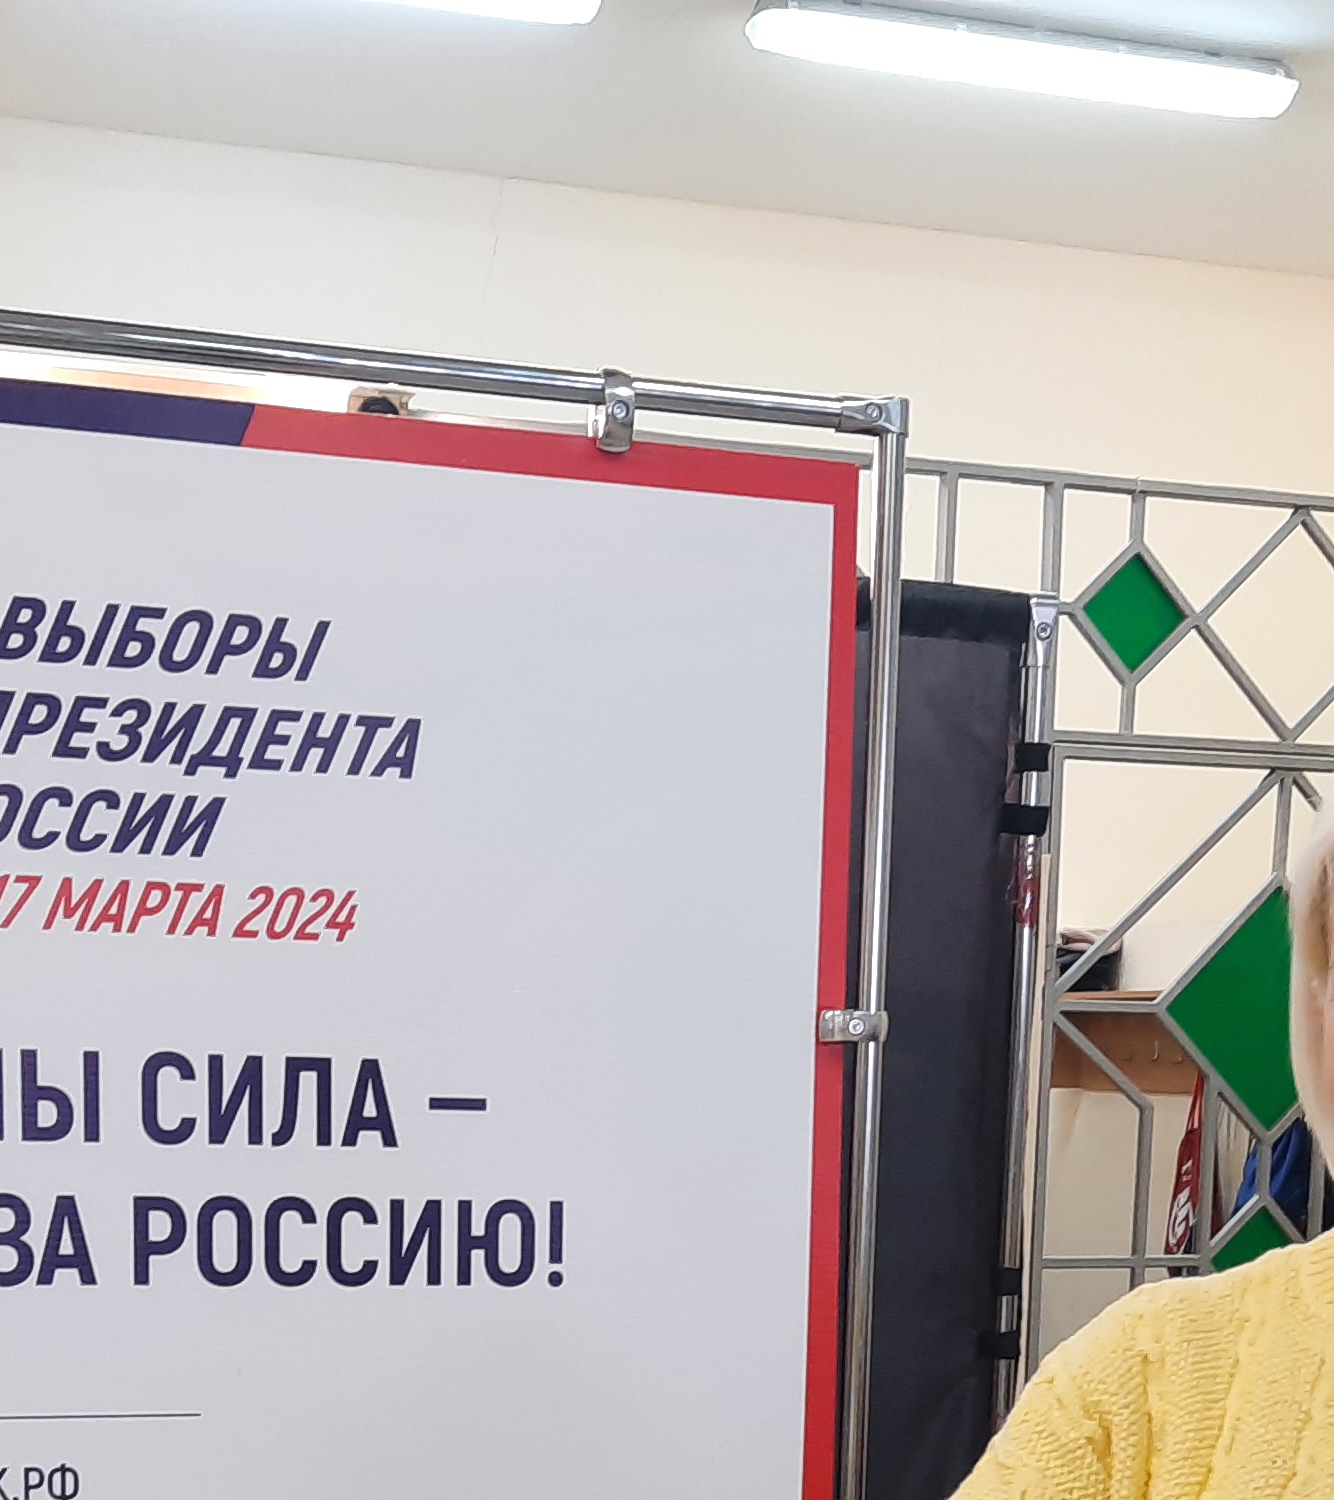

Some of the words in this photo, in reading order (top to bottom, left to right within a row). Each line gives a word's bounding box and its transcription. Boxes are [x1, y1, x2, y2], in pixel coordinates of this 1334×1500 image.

[42, 876, 226, 938] МАРТА
[231, 886, 357, 942] 2024
[140, 1051, 399, 1148] СИЛА
[132, 1195, 564, 1288] РОССИЮ!
